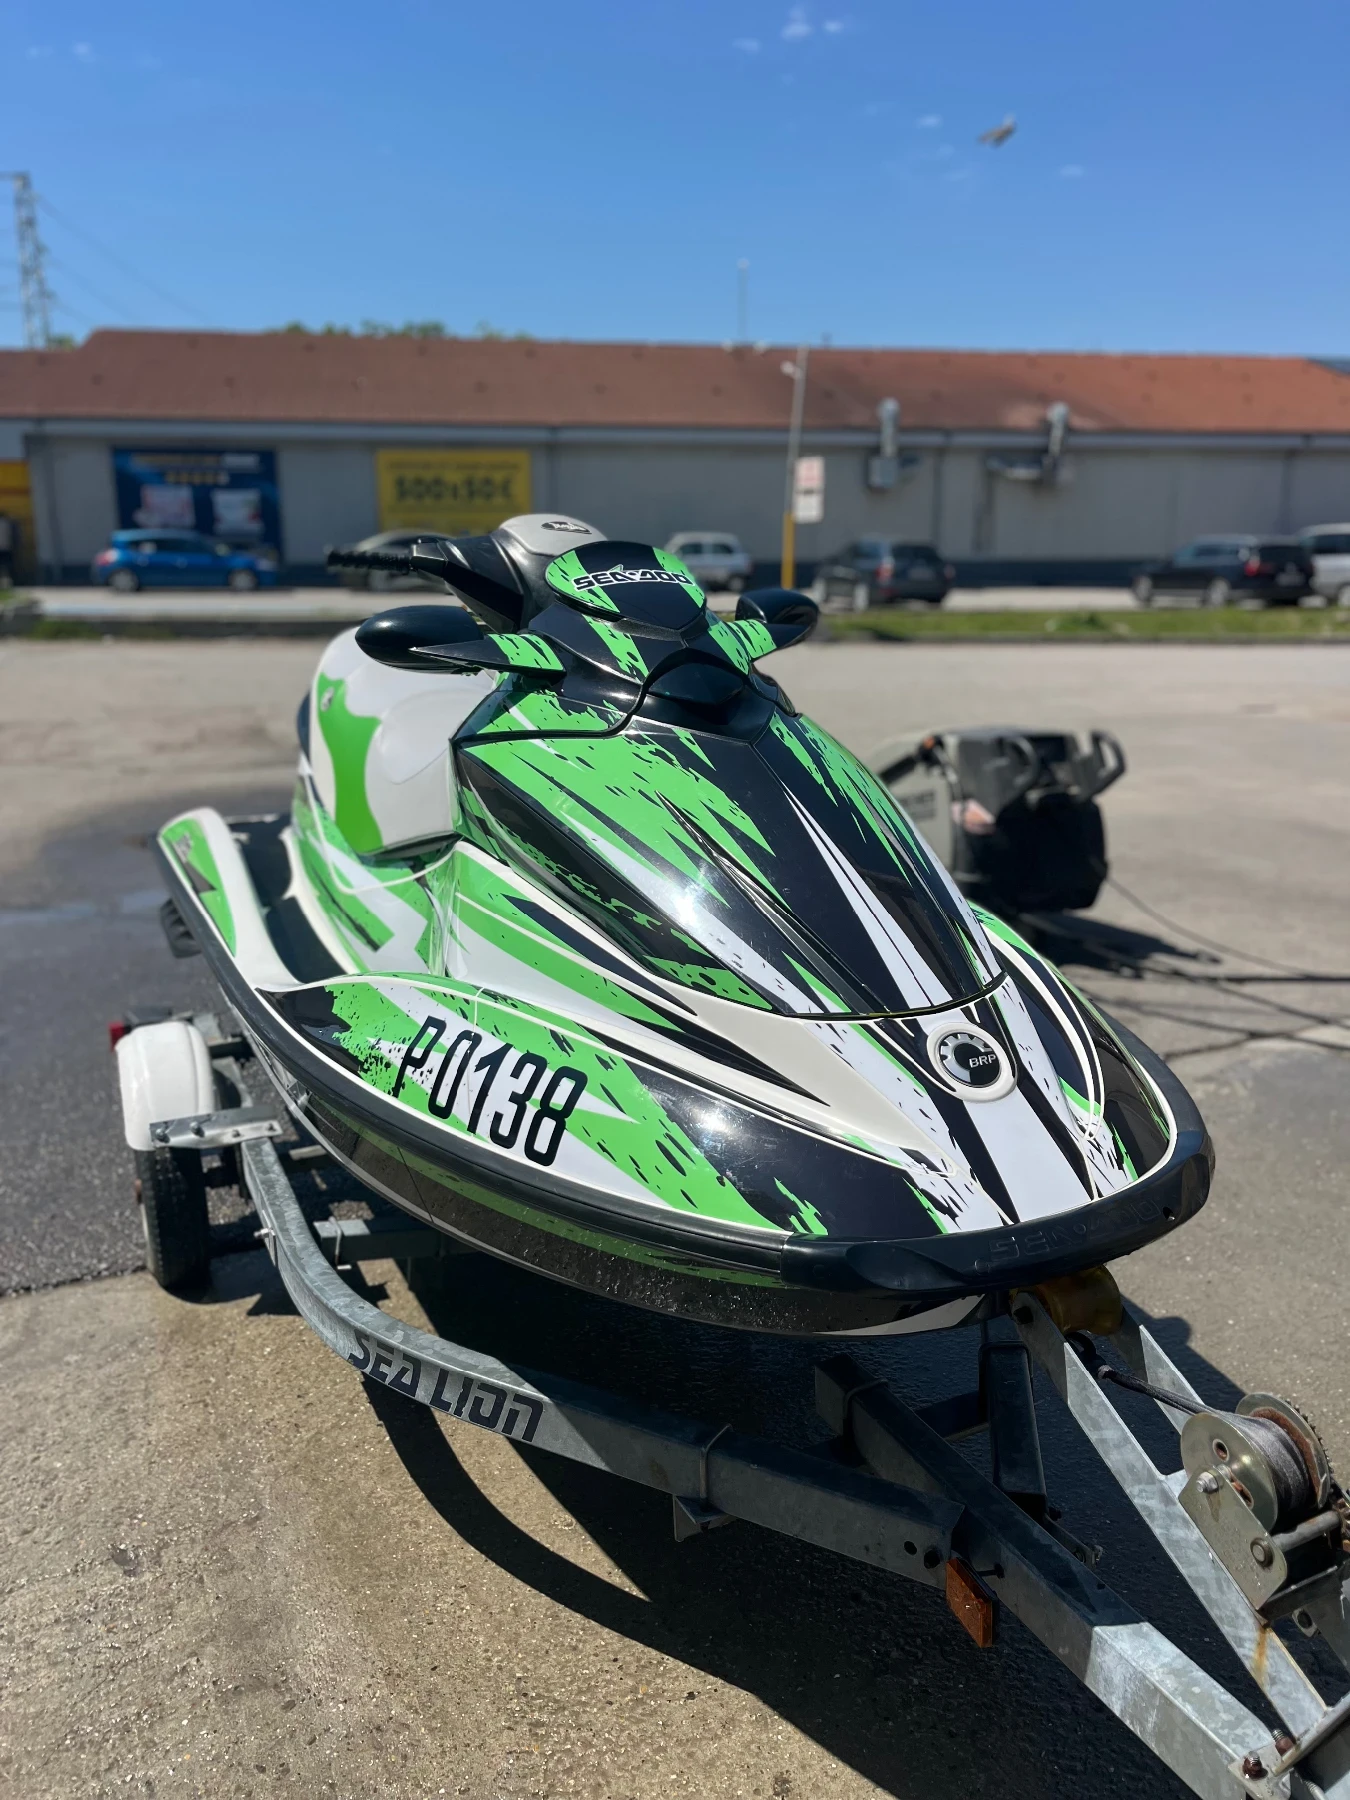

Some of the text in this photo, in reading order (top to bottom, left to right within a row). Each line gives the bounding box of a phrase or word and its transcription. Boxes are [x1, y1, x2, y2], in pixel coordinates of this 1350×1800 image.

[392, 1015, 588, 1167] P0138
[969, 1054, 996, 1068] BRP
[347, 1328, 544, 1443] SEA LION
